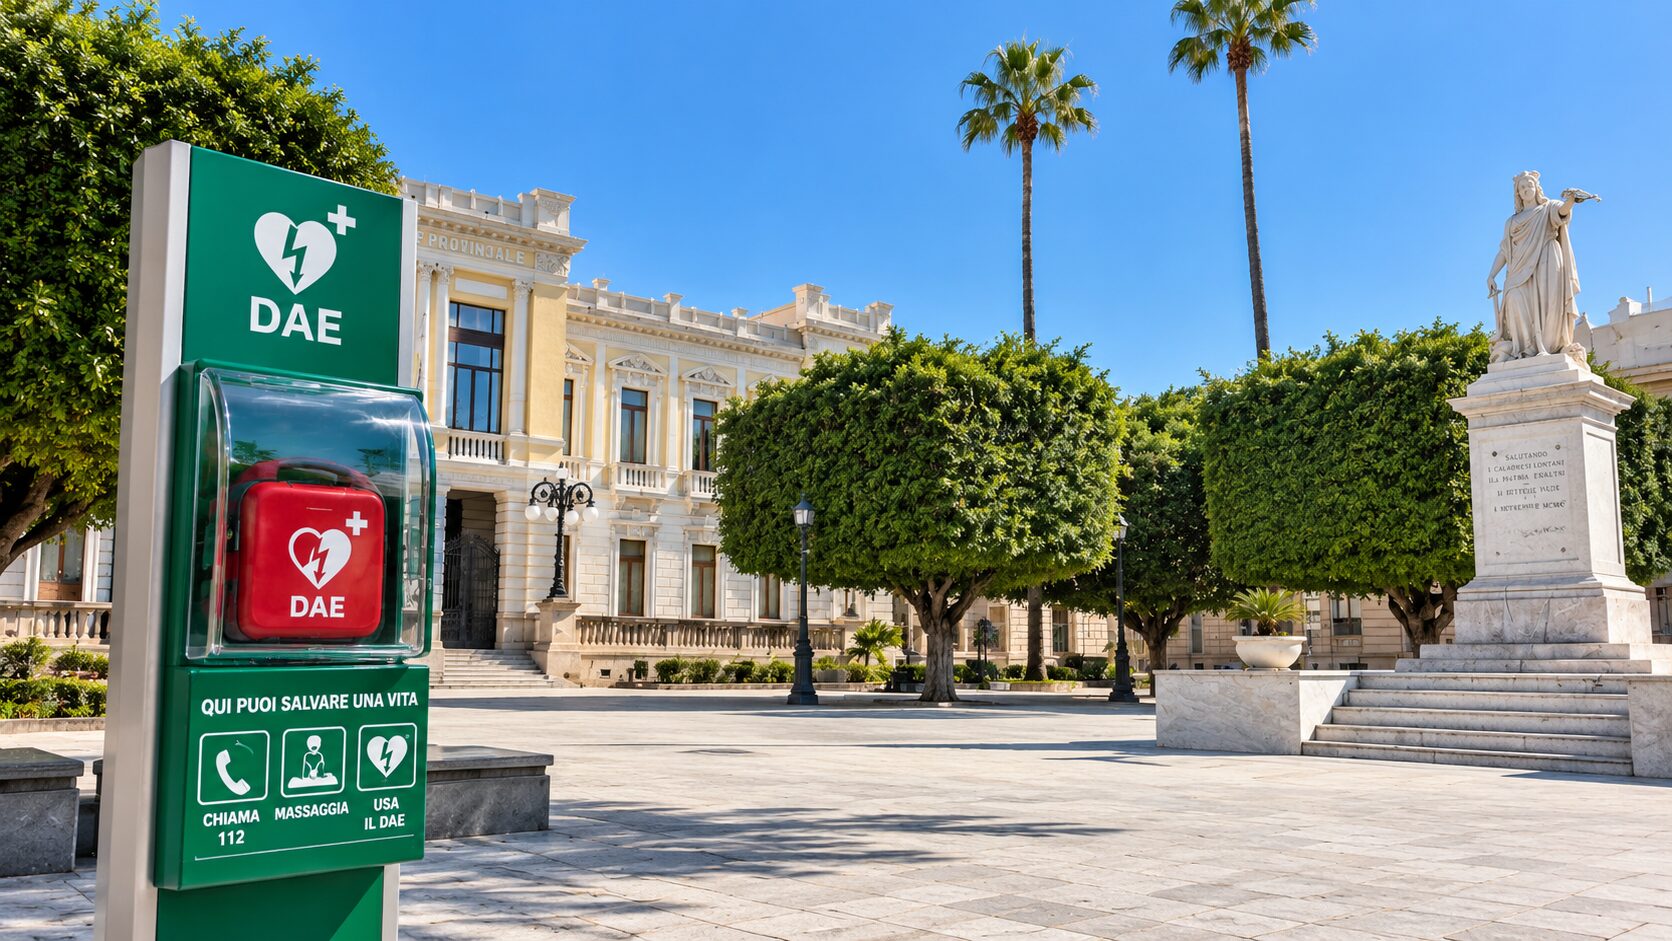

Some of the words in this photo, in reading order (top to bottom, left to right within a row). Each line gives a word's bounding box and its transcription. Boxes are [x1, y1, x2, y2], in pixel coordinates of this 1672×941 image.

[250, 295, 342, 346] DAE
[290, 595, 345, 618] DAE
[201, 698, 231, 717] QUI
[236, 696, 276, 714] PUOI
[281, 693, 349, 711] SALVARE
[353, 693, 384, 708] UNA
[387, 692, 419, 707] VITA
[274, 801, 349, 820] MASSAGGIA
[373, 797, 399, 811] USA
[203, 809, 260, 827] CHIAMA
[364, 817, 376, 830] IL
[379, 813, 405, 829] DAE
[218, 830, 245, 846] 112
